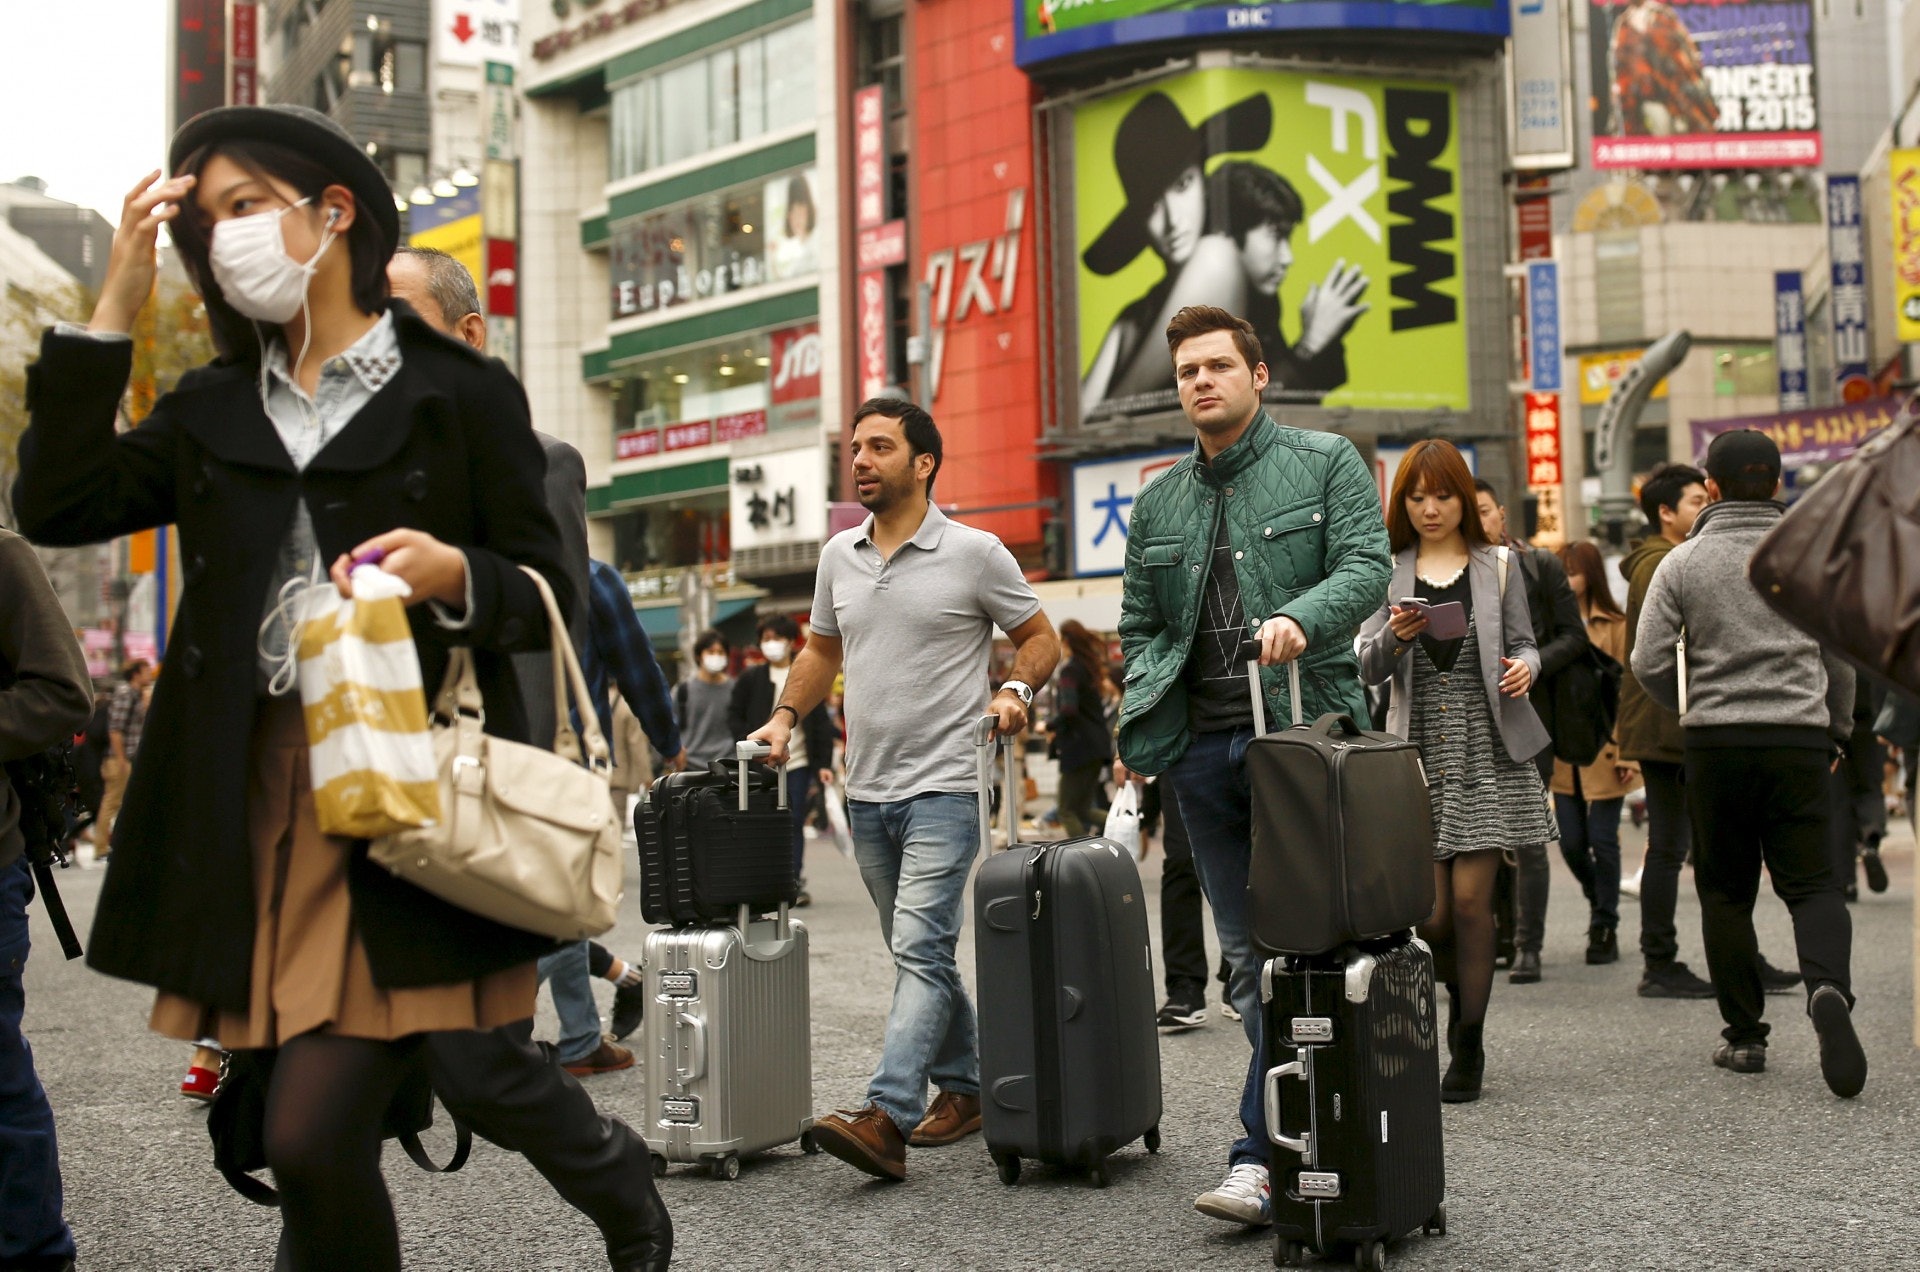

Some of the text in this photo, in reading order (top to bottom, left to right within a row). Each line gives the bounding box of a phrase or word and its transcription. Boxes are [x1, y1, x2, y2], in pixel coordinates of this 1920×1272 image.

[1227, 8, 1272, 28] DHC
[1702, 63, 1813, 97] ONCERT
[1745, 97, 1816, 131] 2015
[1305, 81, 1381, 245] FX
[1384, 88, 1457, 334] DMM
[1829, 182, 1867, 364] 洋服の青山
[774, 334, 820, 390] JTB
